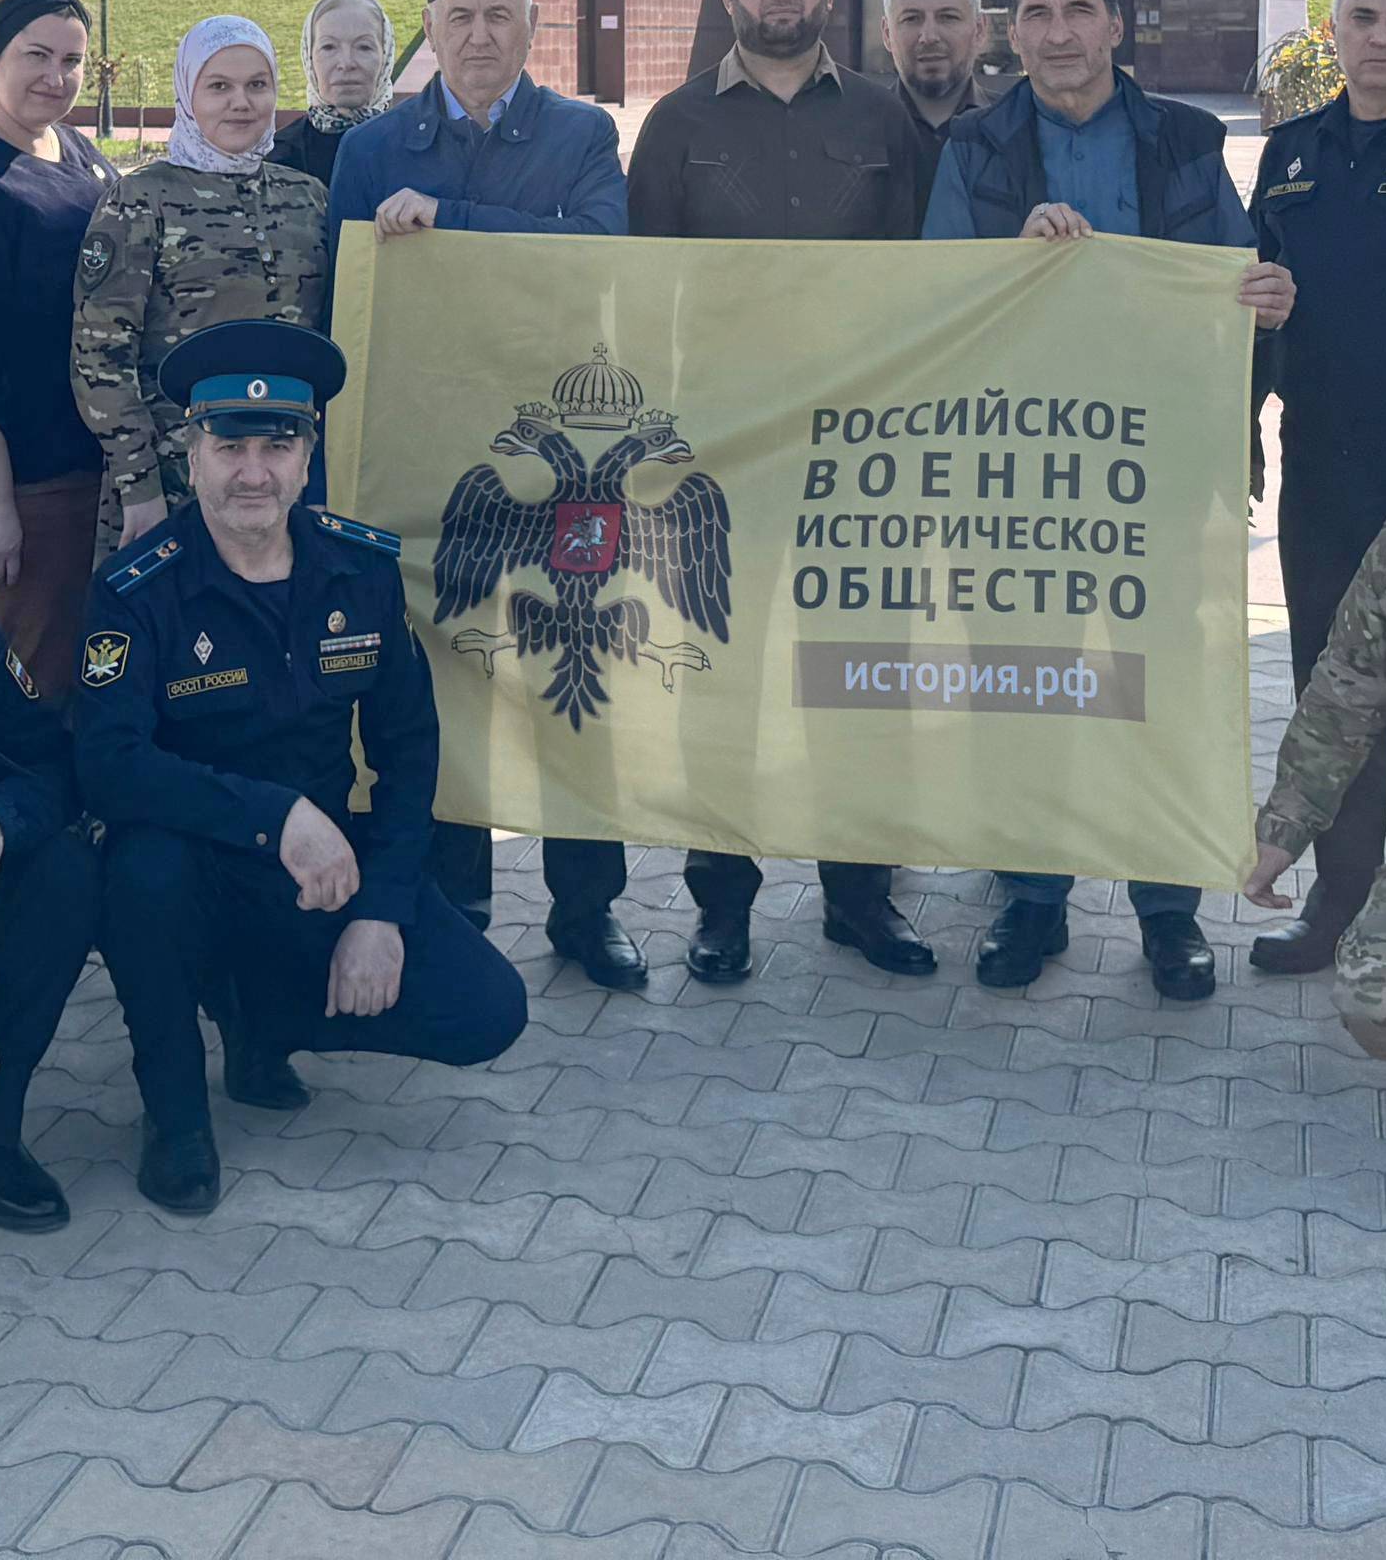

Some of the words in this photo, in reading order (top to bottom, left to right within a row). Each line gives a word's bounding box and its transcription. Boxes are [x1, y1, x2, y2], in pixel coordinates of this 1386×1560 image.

[811, 387, 1147, 447] РОССИЙСКОЕ
[803, 451, 1146, 505] ВОЕННО
[796, 514, 1146, 557] ИСТОРИЧЕСКОЕ
[793, 565, 1146, 622] ОБЩЕСТВО
[171, 679, 201, 694] ФССП
[204, 670, 245, 688] РОССИИ
[844, 658, 1098, 709] история.рф
